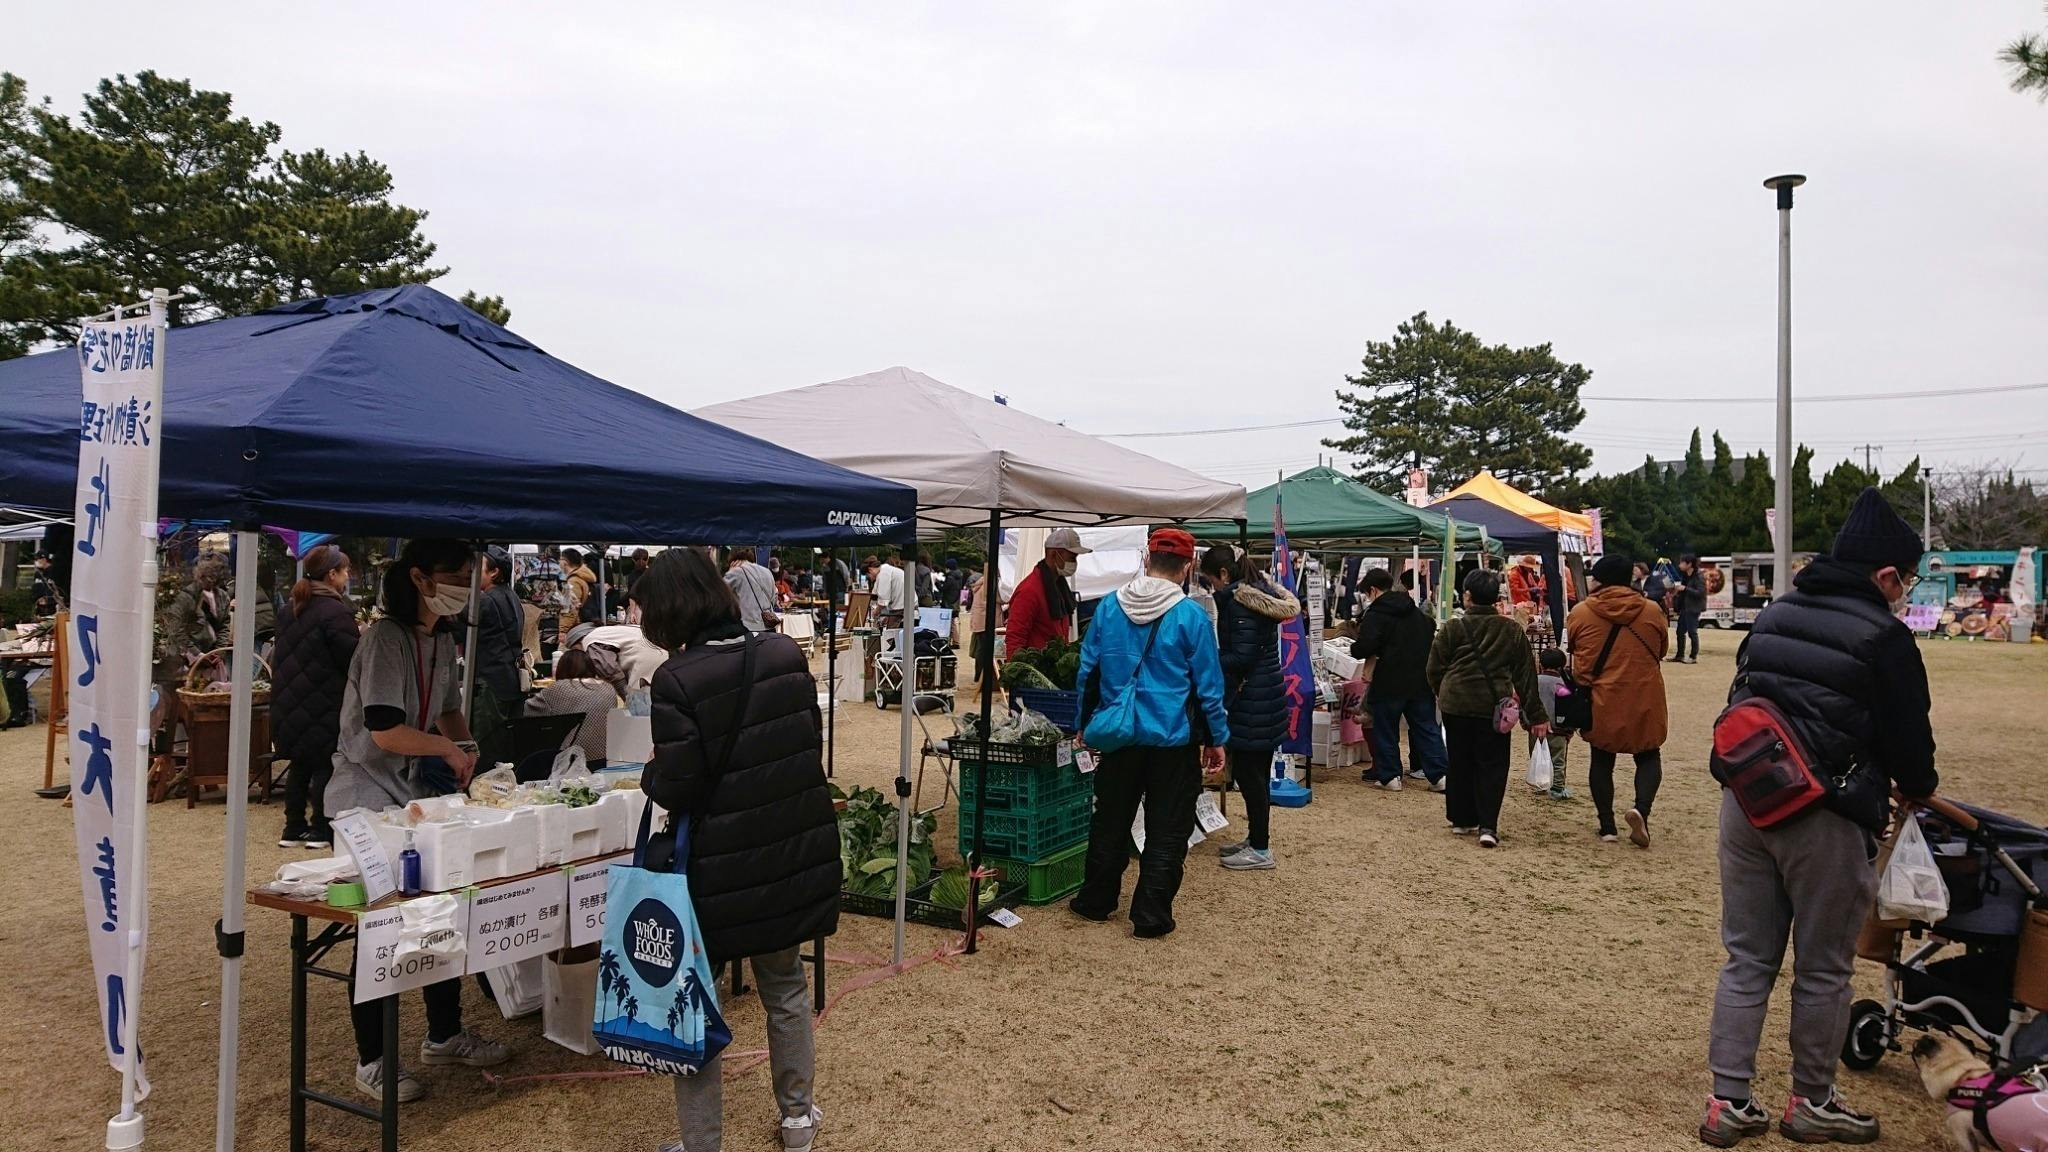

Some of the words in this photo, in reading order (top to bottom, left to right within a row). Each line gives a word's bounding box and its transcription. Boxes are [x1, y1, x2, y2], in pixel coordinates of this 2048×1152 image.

[827, 510, 873, 527] CAPTAIN
[479, 912, 527, 935] ぬか漬け
[538, 903, 560, 921] 各種
[633, 918, 675, 945] WHOLE
[485, 928, 539, 956] 200円
[635, 936, 672, 960] FOODS
[374, 954, 435, 982] 300円
